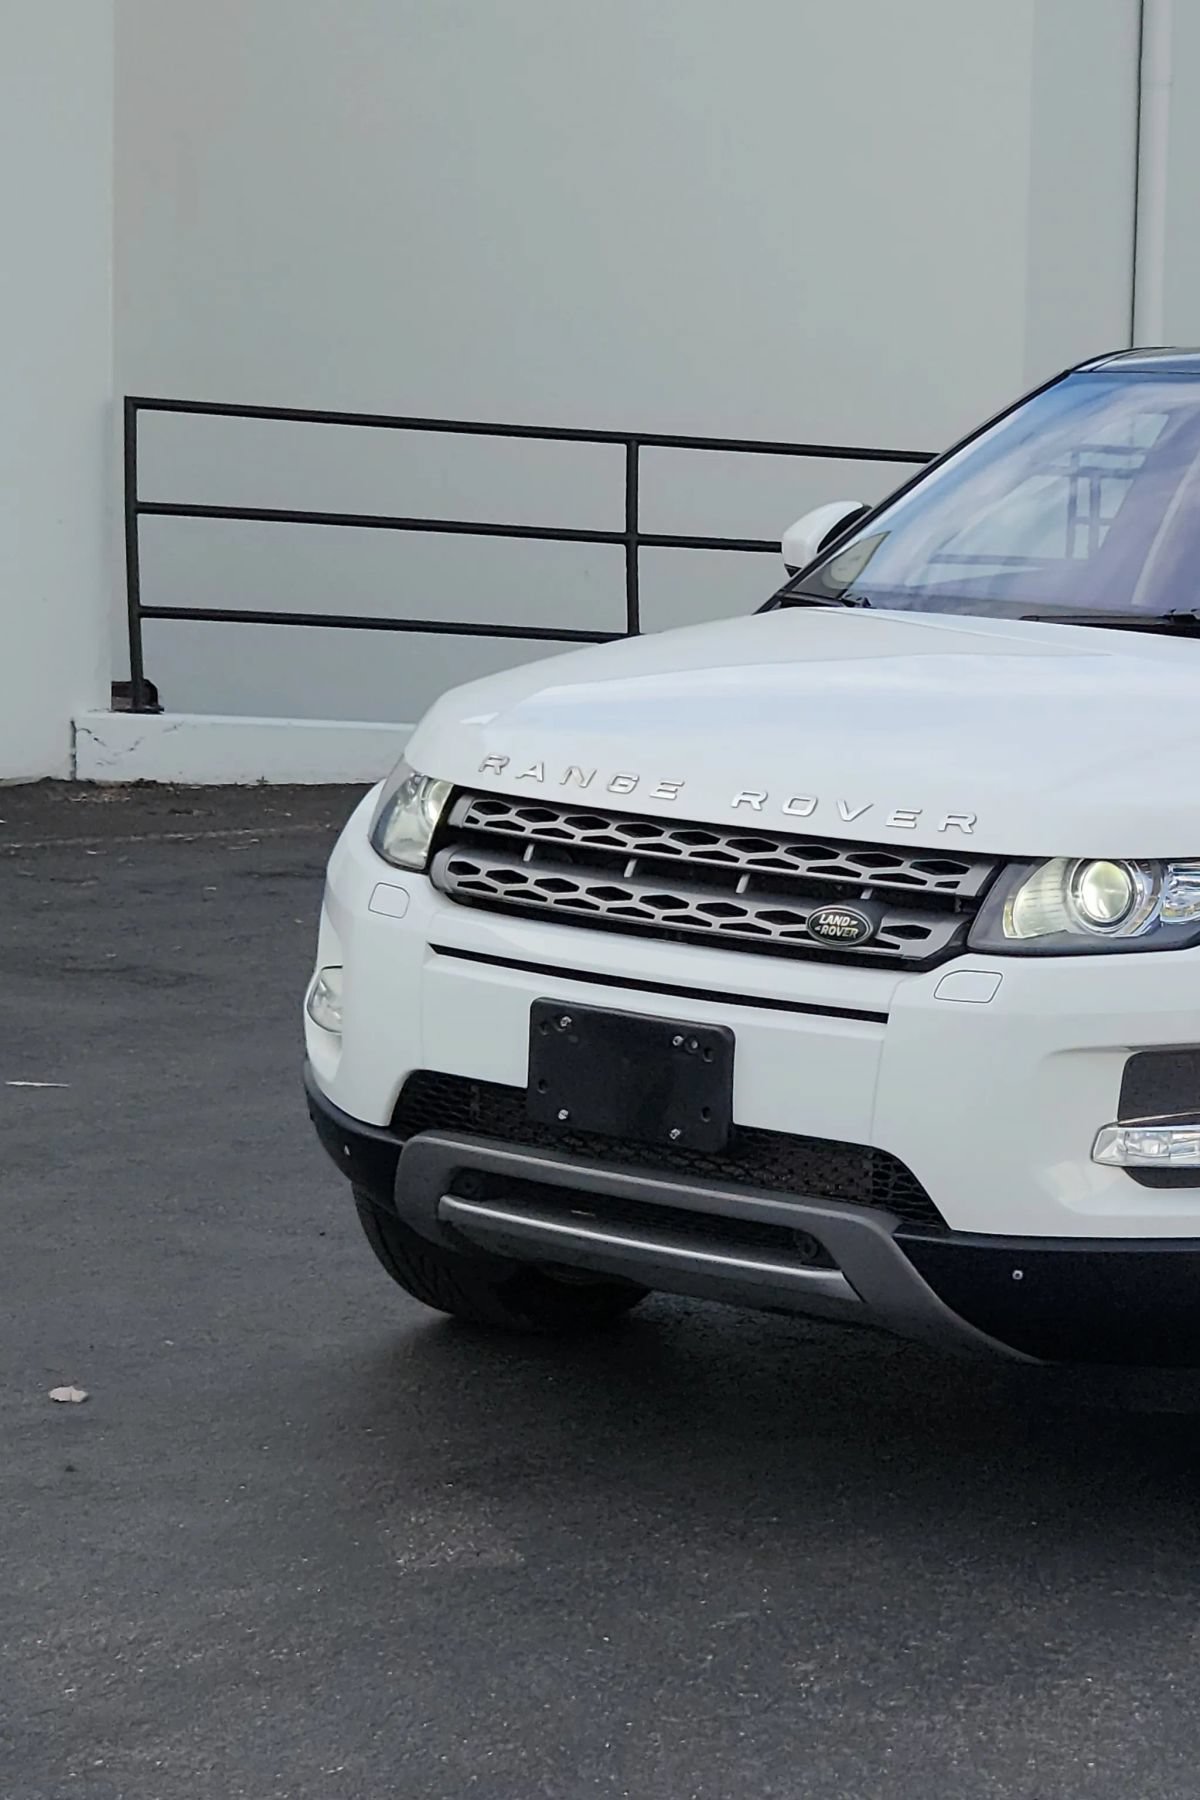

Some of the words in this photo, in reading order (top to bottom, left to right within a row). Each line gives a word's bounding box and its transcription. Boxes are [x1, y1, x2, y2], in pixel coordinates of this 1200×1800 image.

[478, 754, 686, 801] RANGE
[730, 790, 977, 834] ROVER
[819, 914, 851, 926] LAND
[820, 925, 859, 938] ROVER
